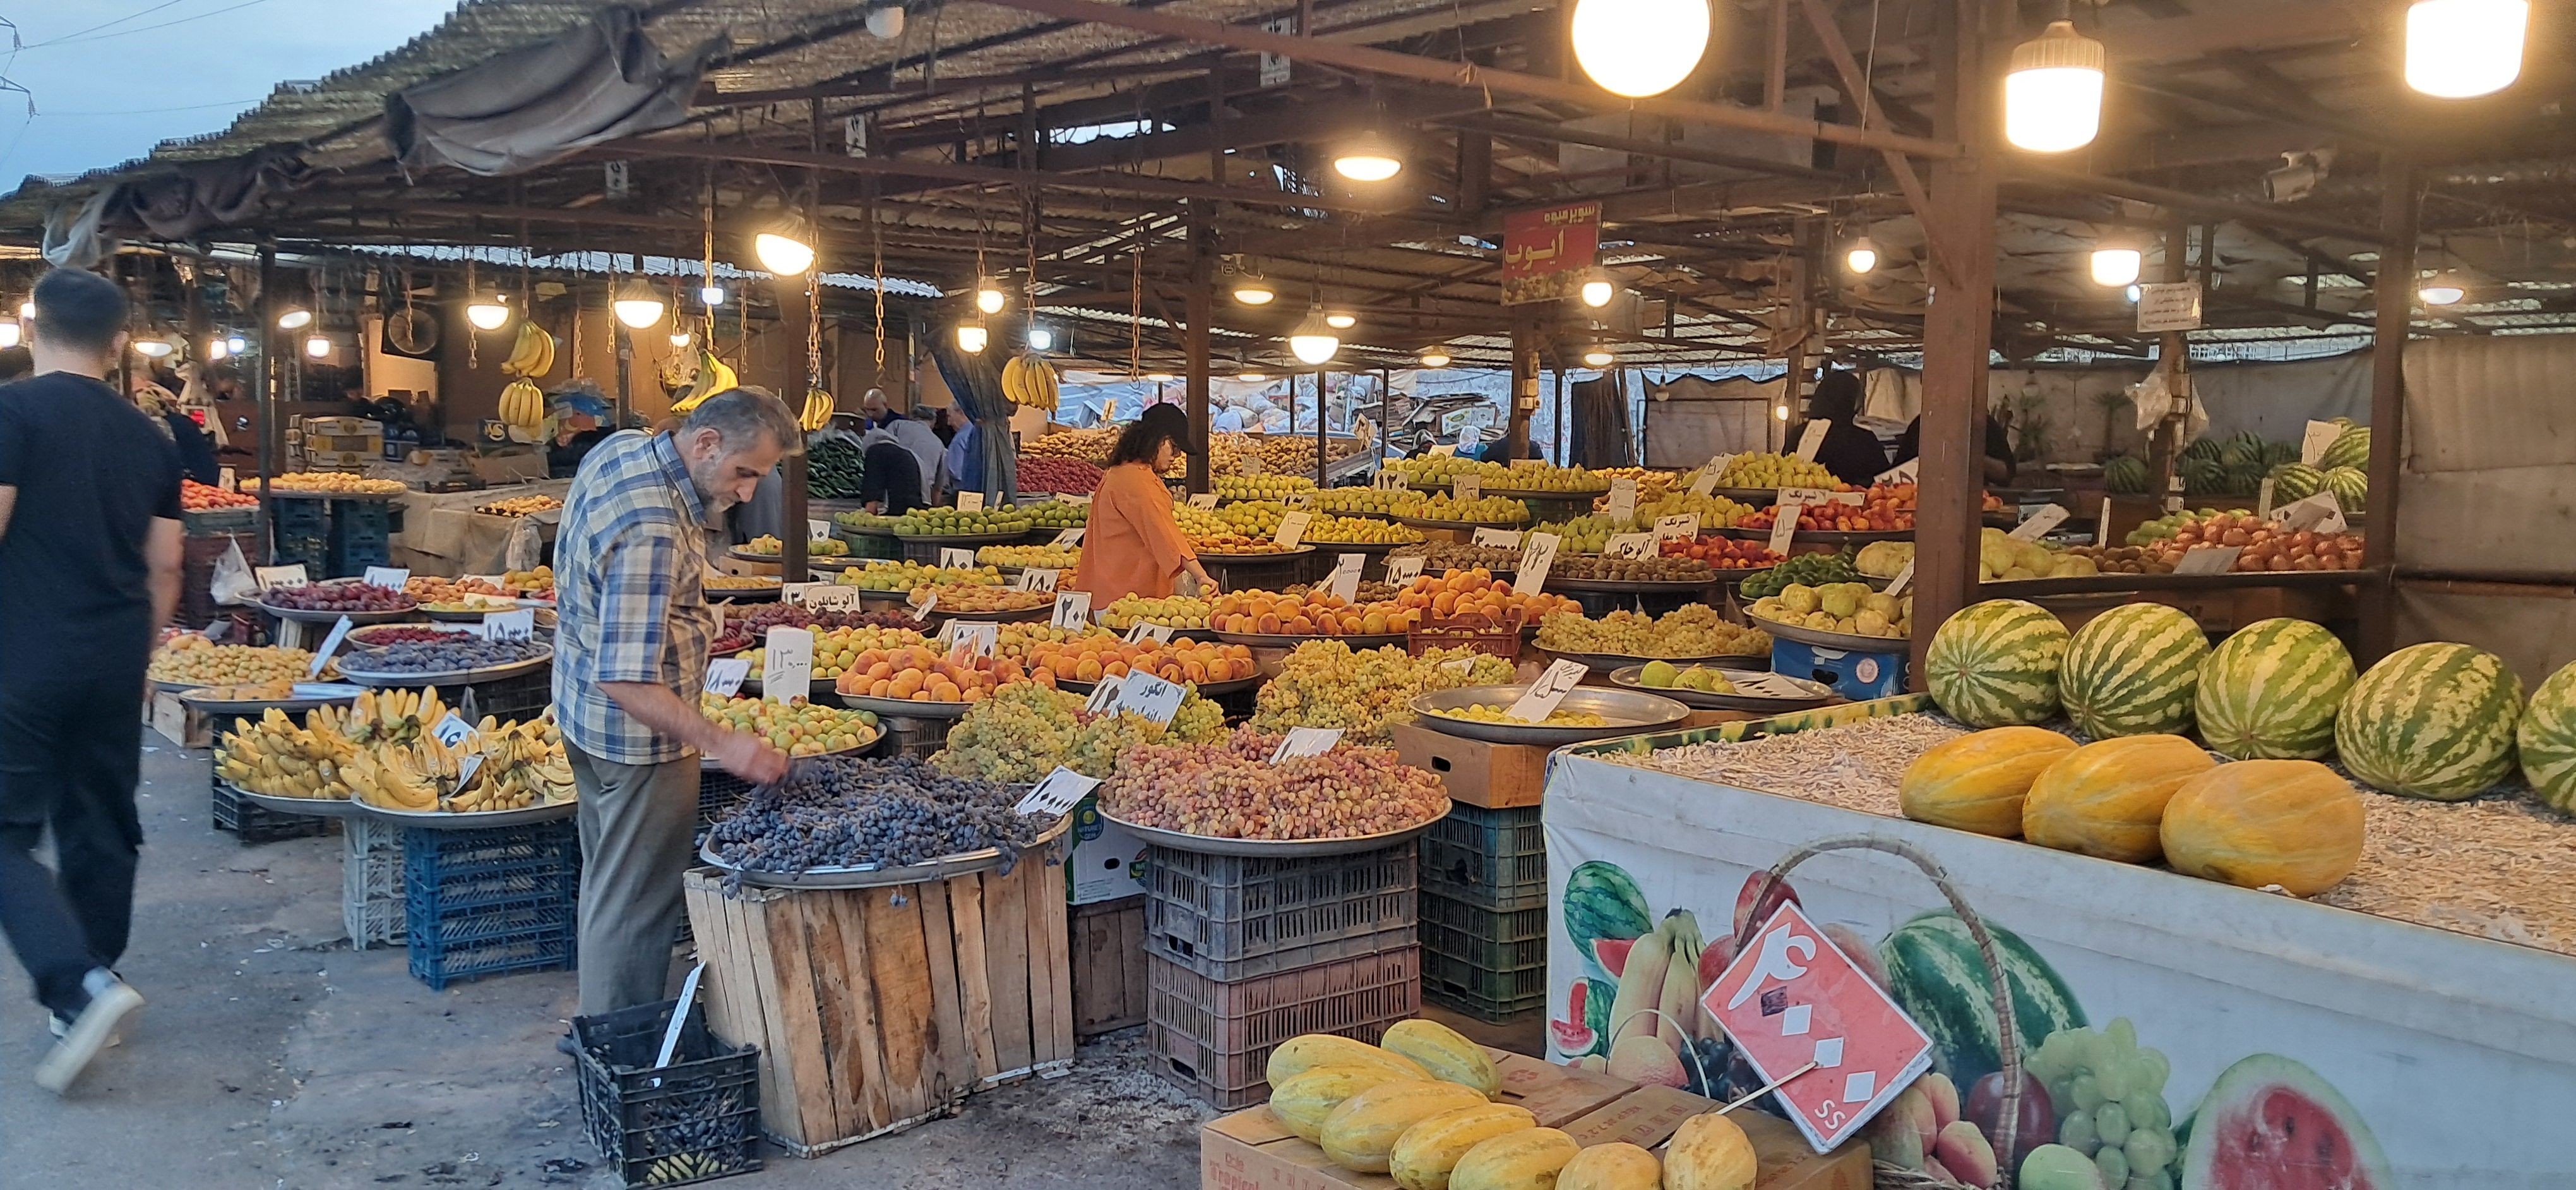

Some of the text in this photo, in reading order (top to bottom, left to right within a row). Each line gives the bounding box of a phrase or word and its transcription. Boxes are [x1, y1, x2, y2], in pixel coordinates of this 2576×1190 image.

[1505, 228, 1565, 271] ایوب
[842, 592, 854, 609] آلو
[1140, 681, 1169, 698] انگور
